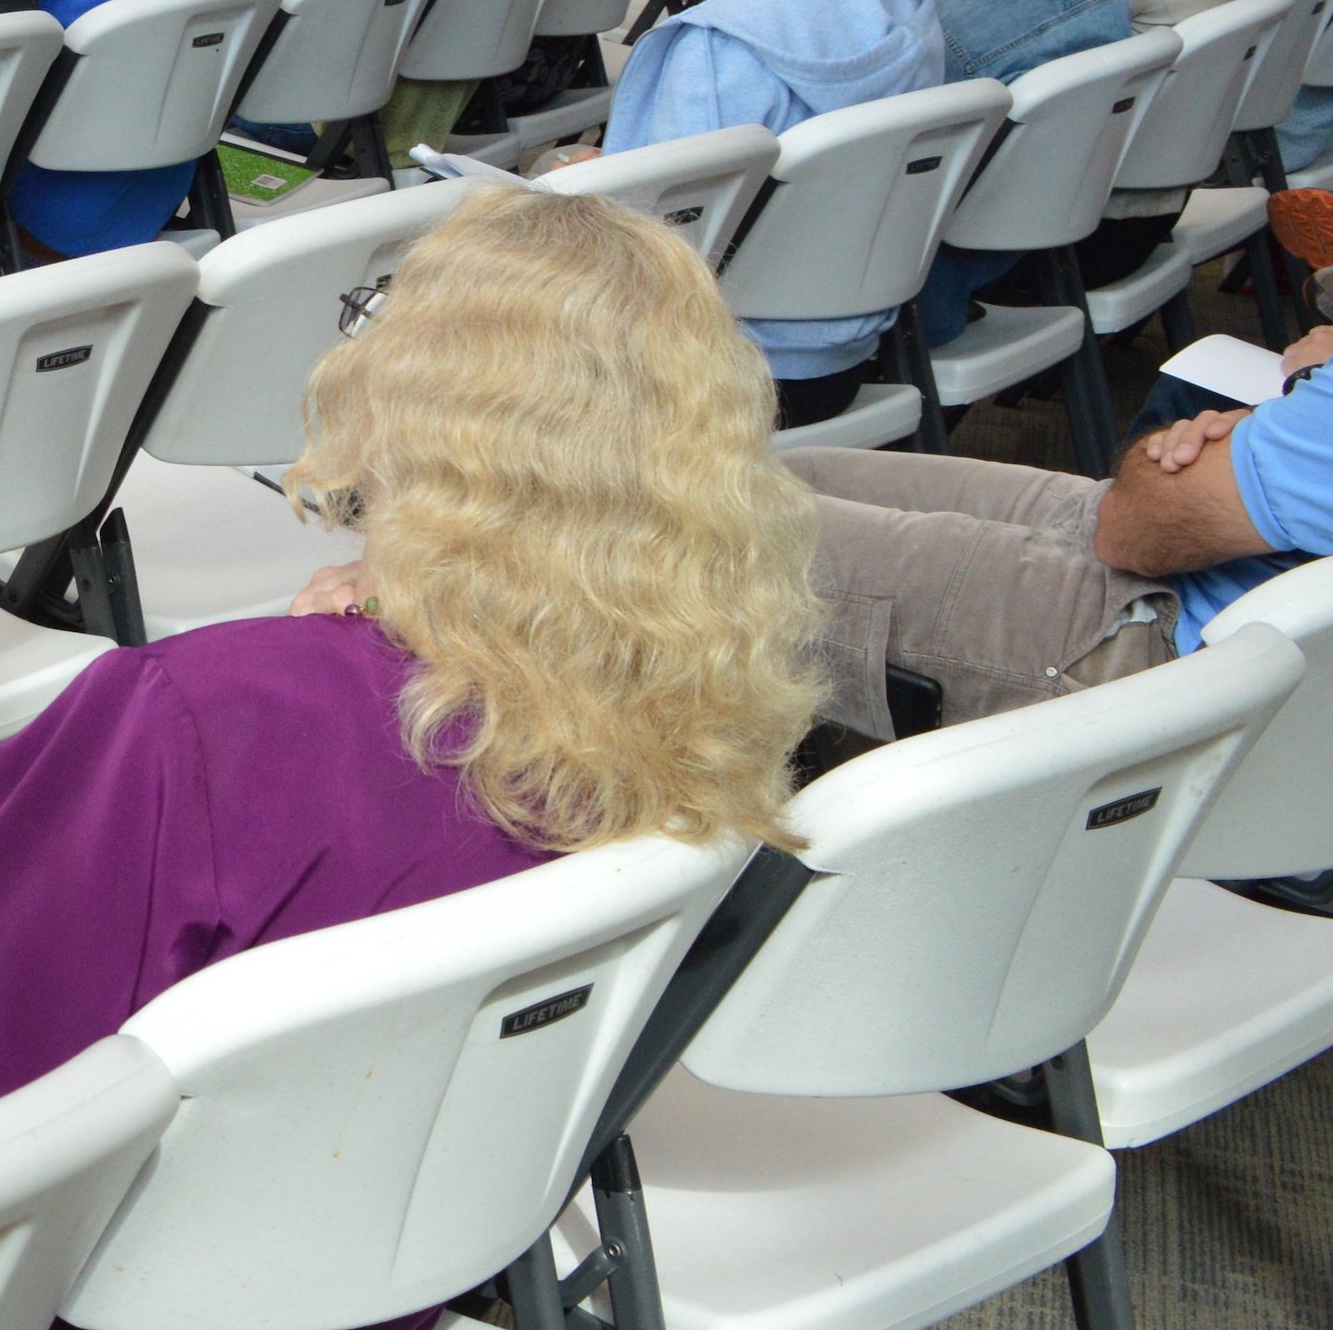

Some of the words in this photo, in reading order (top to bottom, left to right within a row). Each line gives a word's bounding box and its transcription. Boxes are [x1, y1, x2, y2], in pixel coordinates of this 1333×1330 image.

[43, 350, 88, 369] LIFETIME
[1096, 794, 1153, 824] LIFETIME
[513, 992, 583, 1031] LIFETIME
